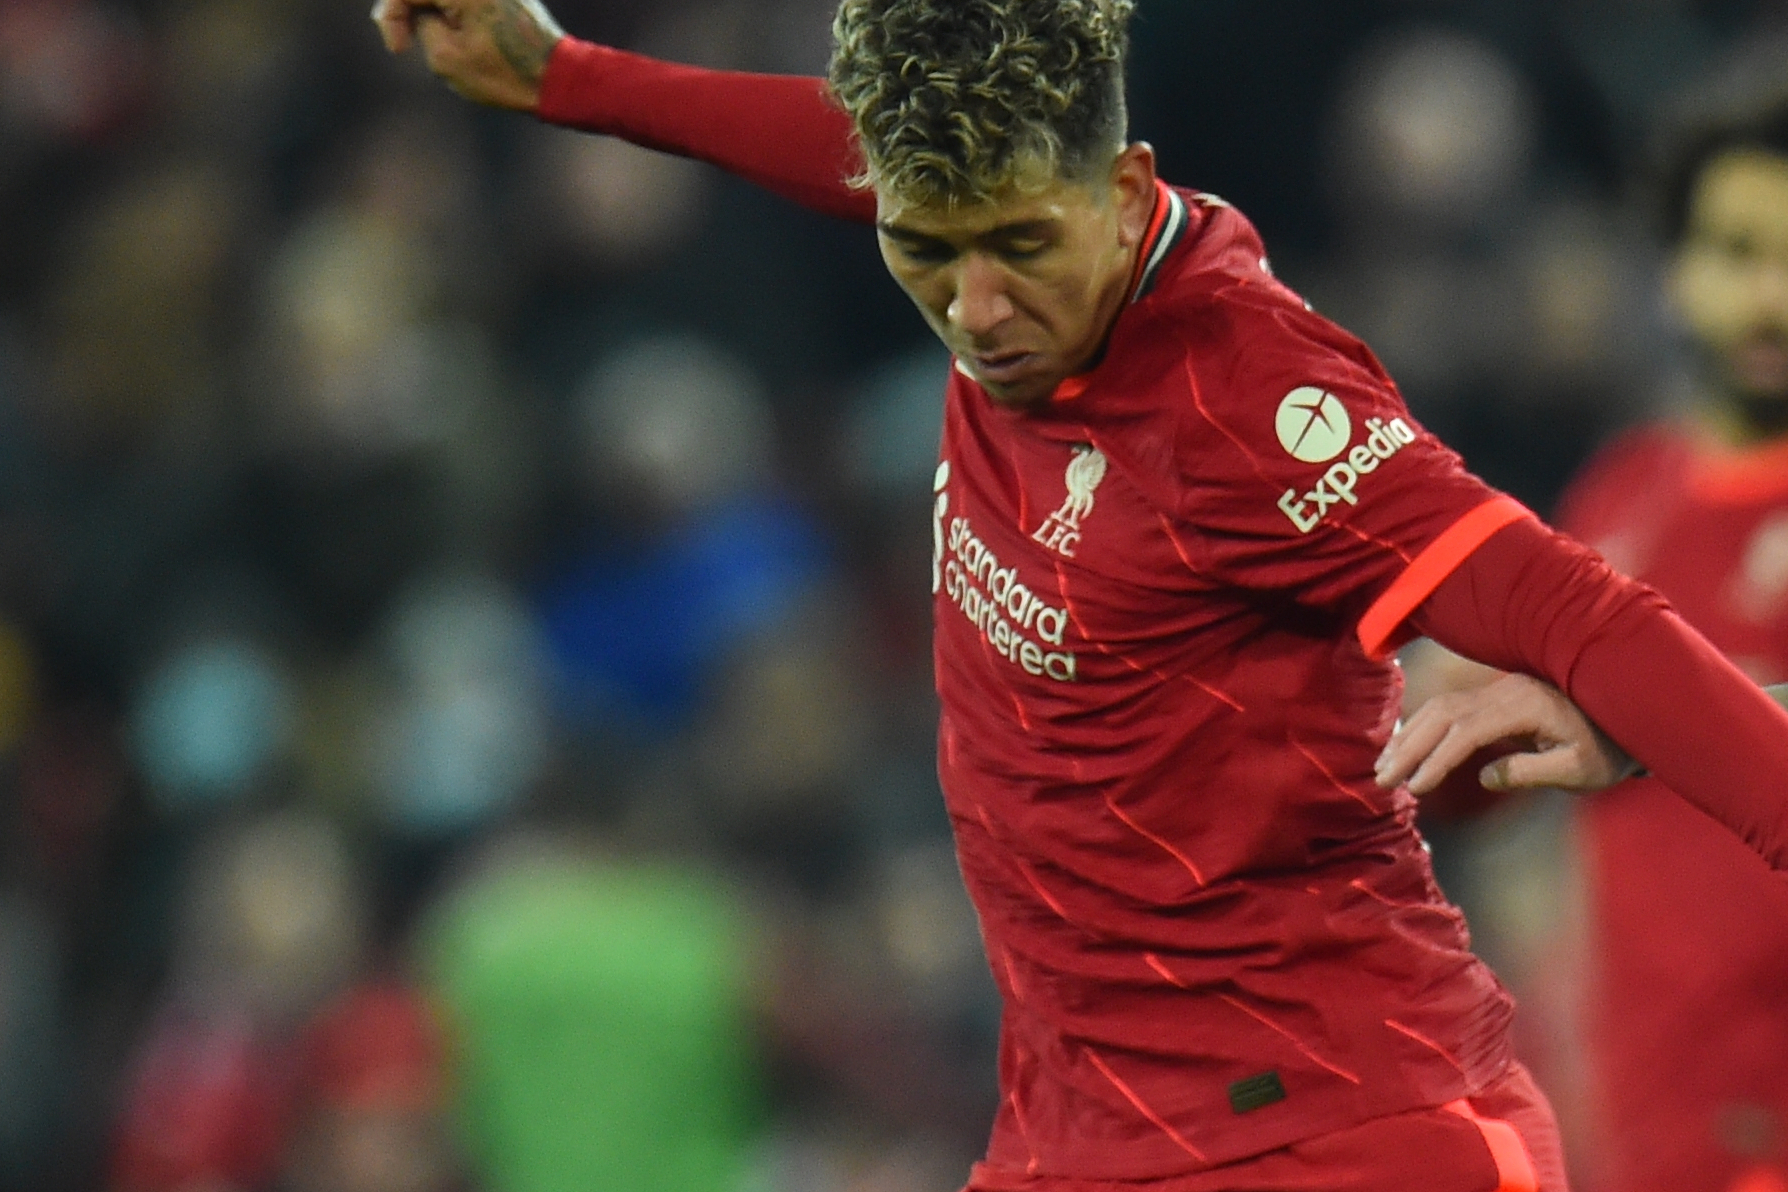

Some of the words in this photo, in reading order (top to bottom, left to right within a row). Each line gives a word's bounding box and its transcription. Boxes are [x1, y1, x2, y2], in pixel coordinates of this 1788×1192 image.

[1277, 417, 1416, 533] Expedia
[948, 516, 1069, 646] standard
[1031, 519, 1081, 557] LFC
[945, 559, 1077, 682] chartered
